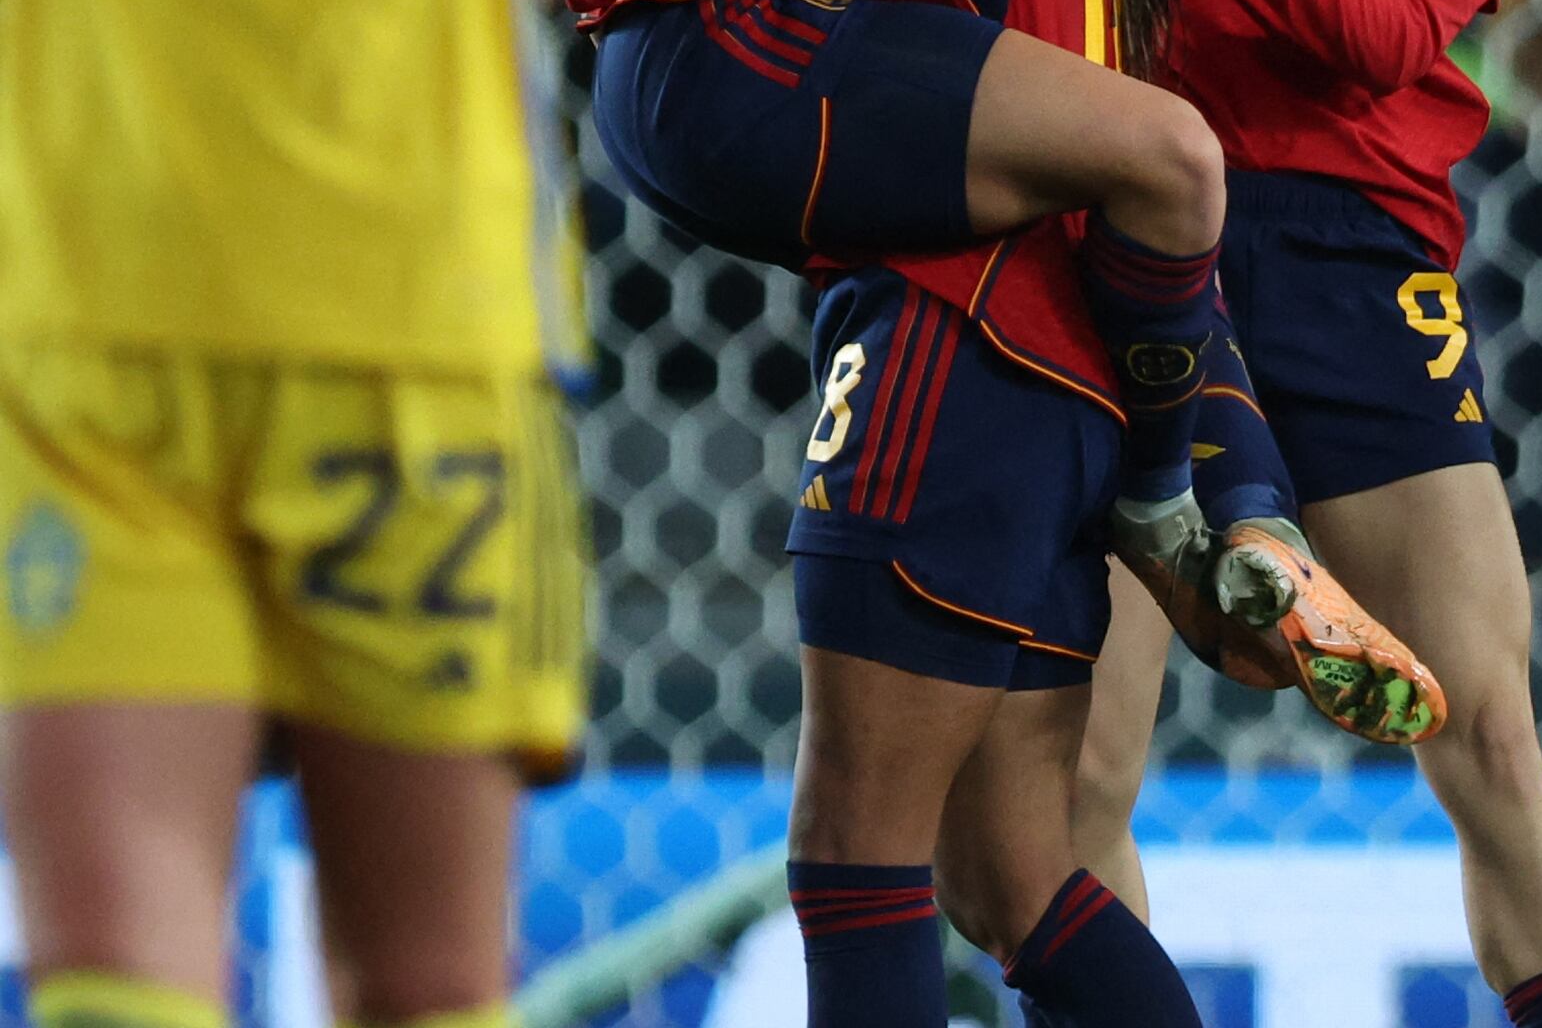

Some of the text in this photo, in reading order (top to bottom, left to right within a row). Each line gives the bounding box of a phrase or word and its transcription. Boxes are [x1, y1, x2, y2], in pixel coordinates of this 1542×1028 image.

[1397, 272, 1468, 380] 9
[806, 343, 866, 463] 8
[306, 451, 506, 618] 22
